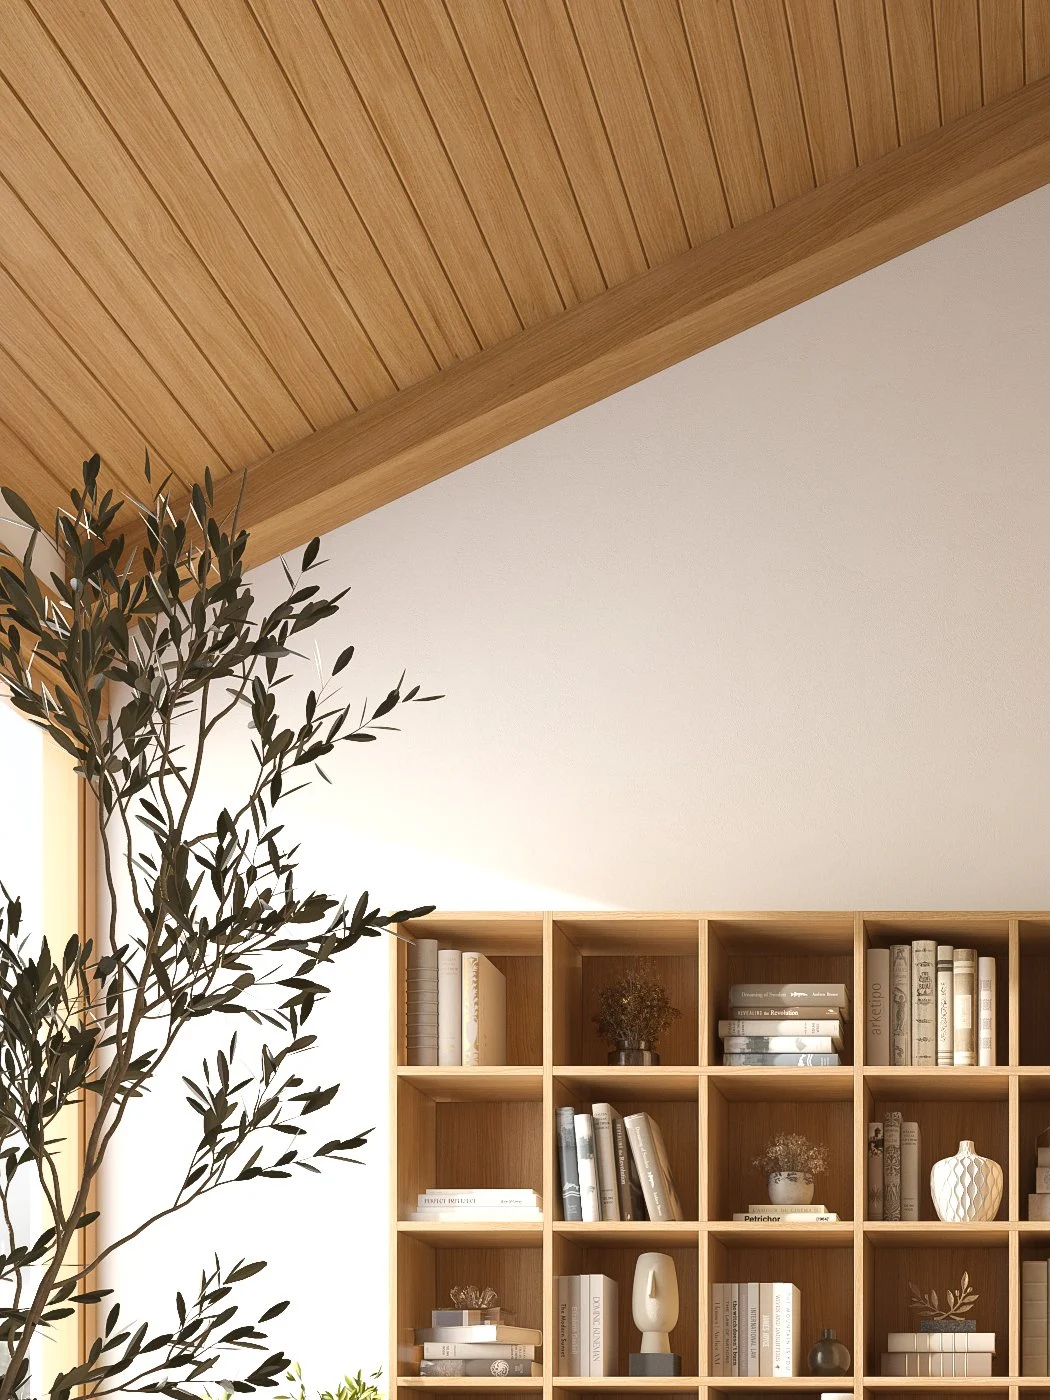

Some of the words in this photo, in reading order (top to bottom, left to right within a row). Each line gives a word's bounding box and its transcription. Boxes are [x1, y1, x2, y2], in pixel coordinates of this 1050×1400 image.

[868, 982, 885, 1036] arketipo
[619, 1156, 627, 1185] Revolution
[592, 1296, 601, 1326] DOMINIC
[725, 1328, 730, 1336] OF
